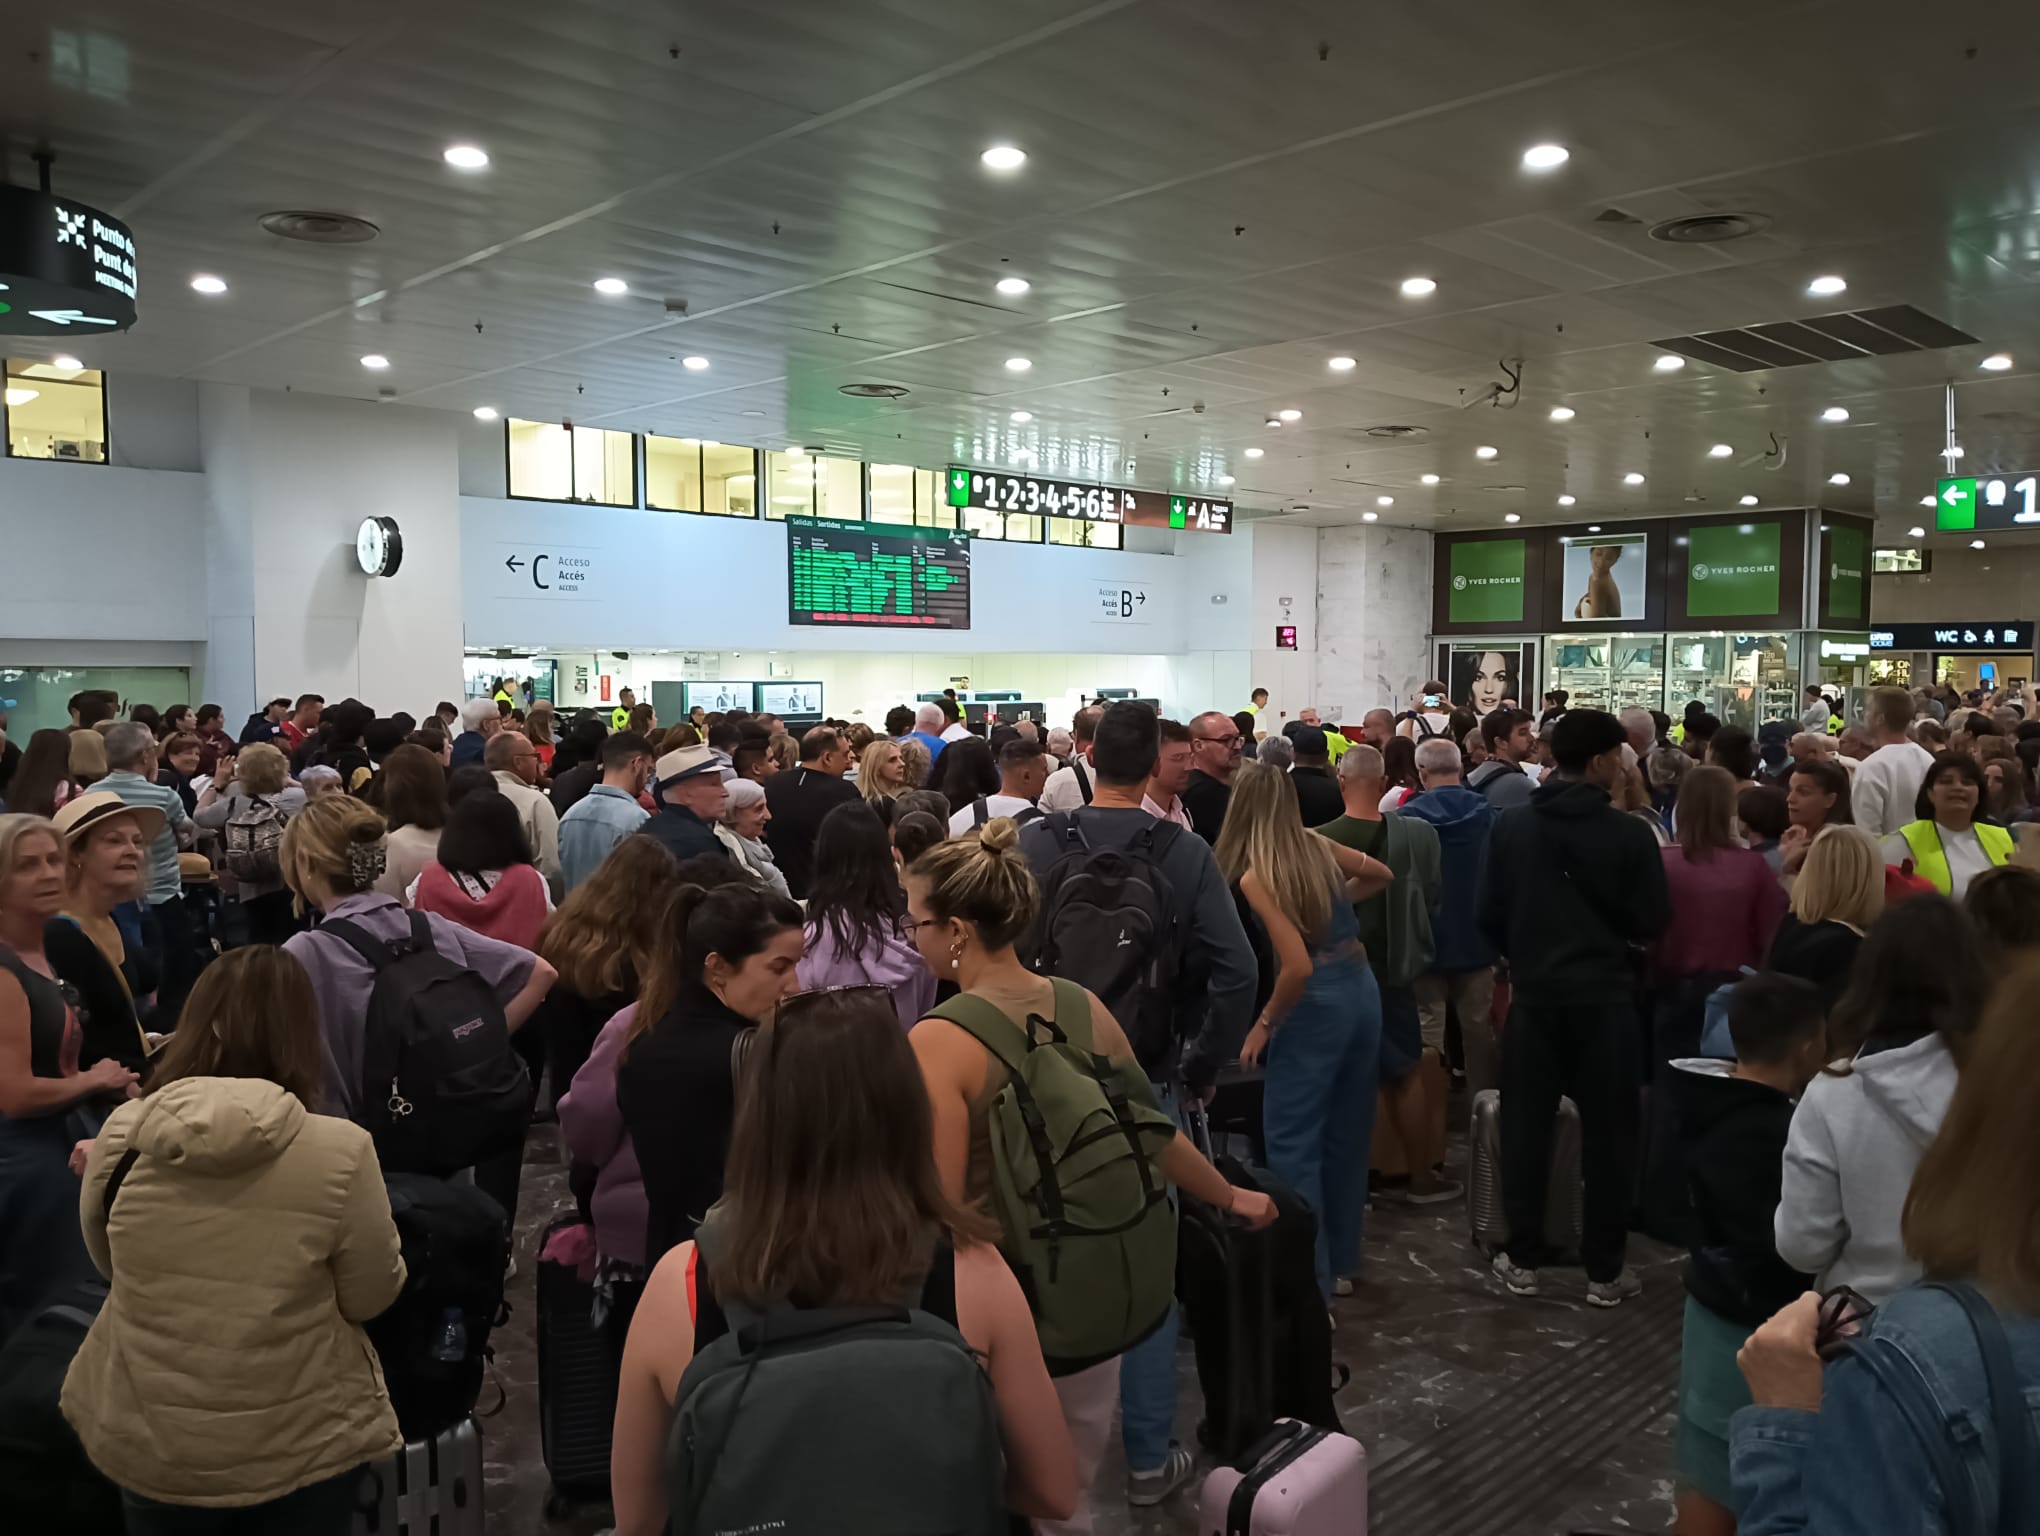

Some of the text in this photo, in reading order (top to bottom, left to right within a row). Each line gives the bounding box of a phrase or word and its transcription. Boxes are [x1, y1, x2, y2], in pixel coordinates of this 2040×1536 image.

[92, 218, 125, 250] Punto
[94, 244, 122, 272] Punt
[1196, 502, 1210, 529] A
[559, 556, 590, 567] Acceso
[1736, 565, 1775, 574] ROCHER
[532, 555, 550, 589] C
[558, 570, 585, 581] Accés
[1489, 576, 1521, 584] ROCHER
[1121, 590, 1133, 617] B
[1935, 630, 1959, 643] WC
